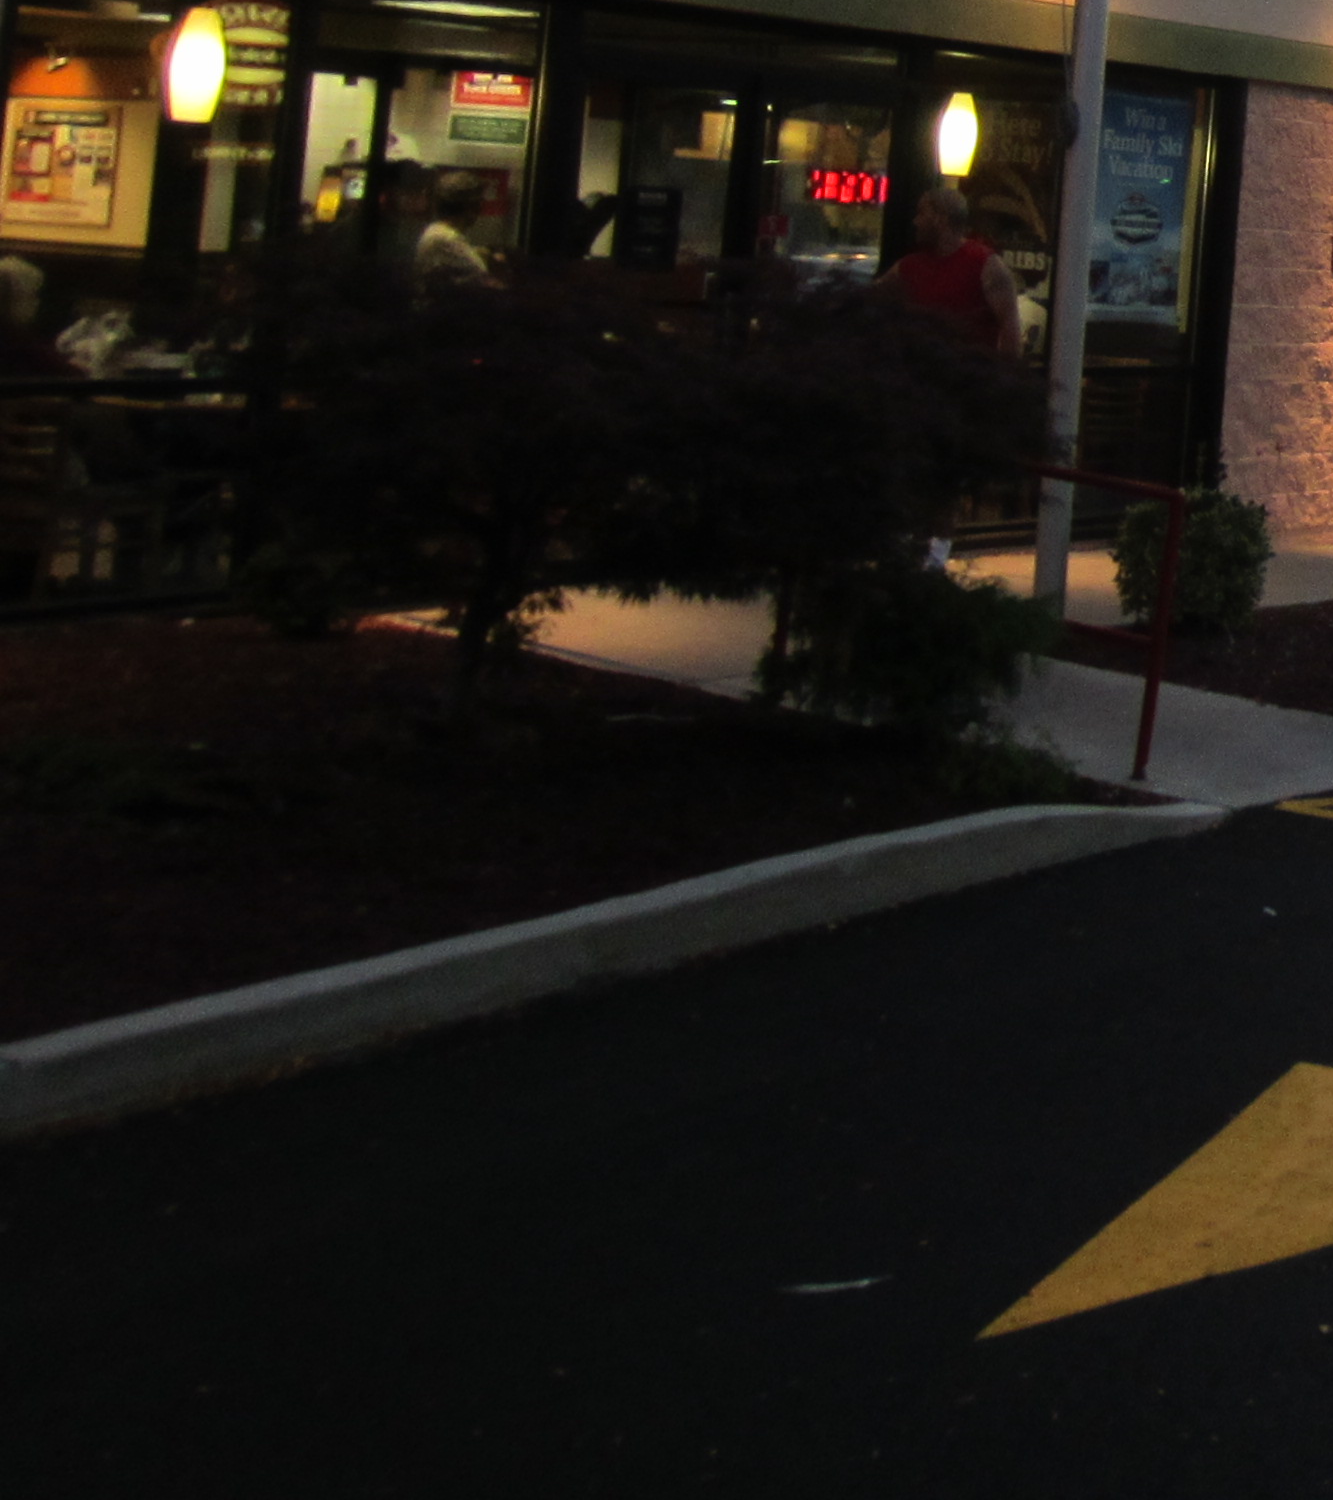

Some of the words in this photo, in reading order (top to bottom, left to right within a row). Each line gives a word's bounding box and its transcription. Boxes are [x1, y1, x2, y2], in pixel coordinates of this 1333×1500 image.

[1125, 106, 1155, 130] Win
[1157, 115, 1168, 131] a
[1103, 128, 1155, 158] Family
[1157, 134, 1184, 158] Ski
[1108, 154, 1174, 181] Vacation
[1002, 249, 1046, 272] RIBS
